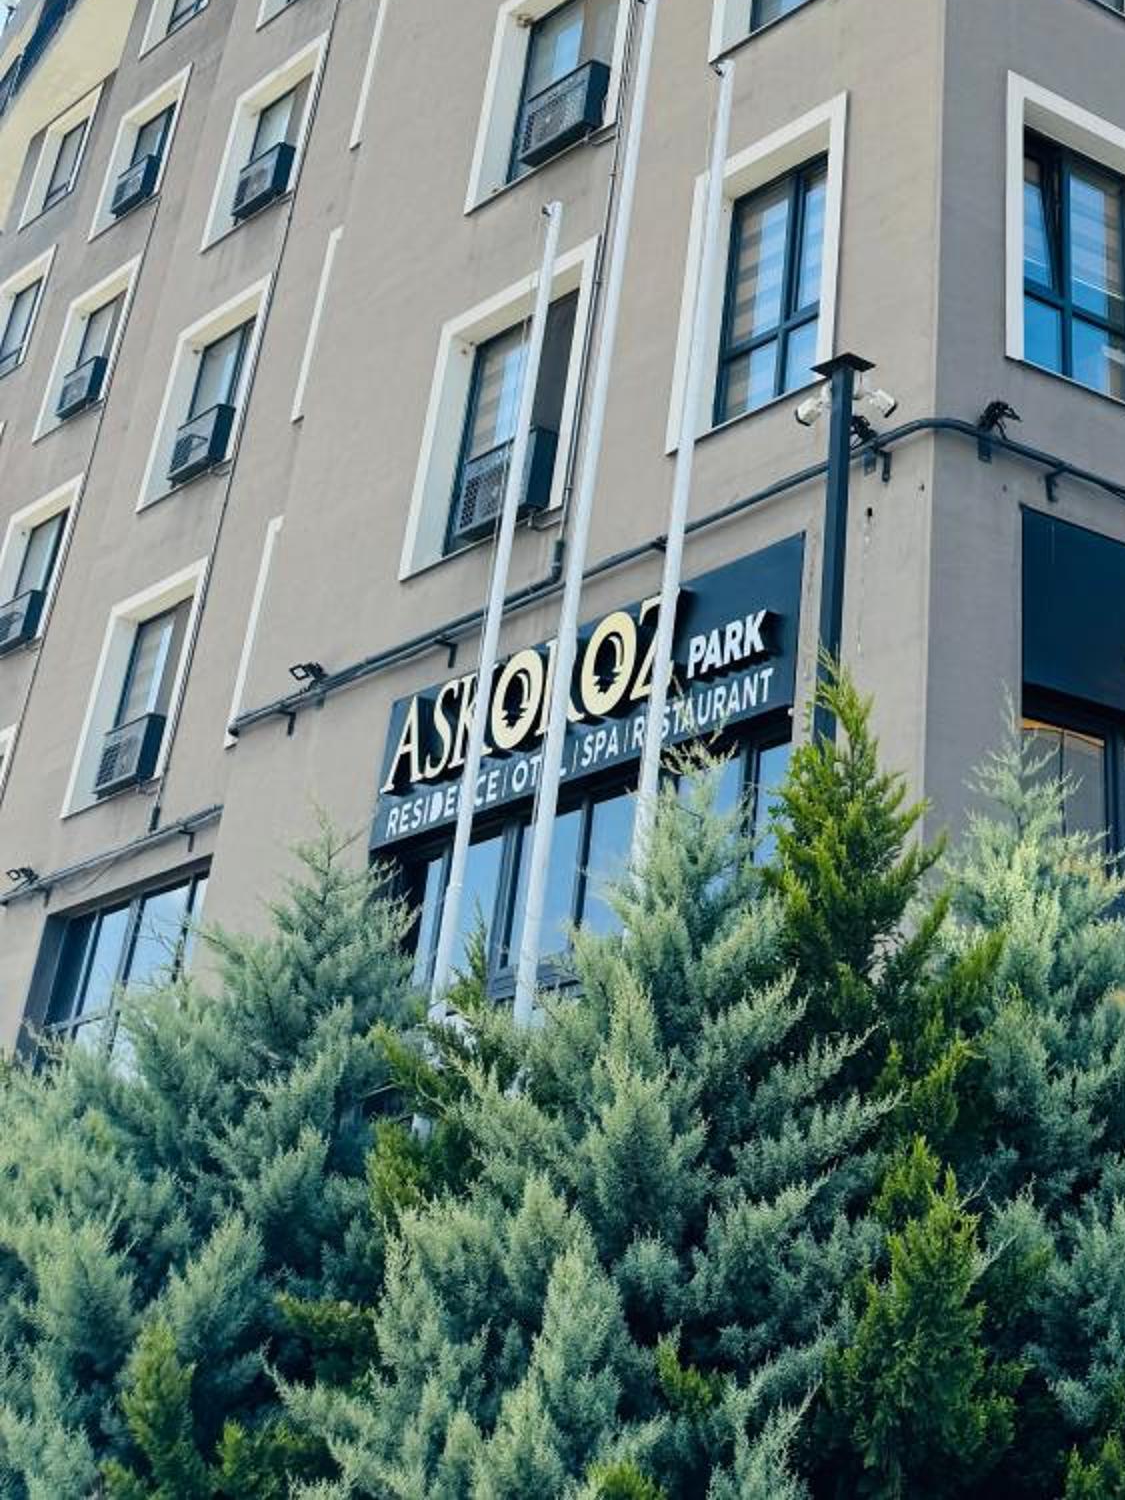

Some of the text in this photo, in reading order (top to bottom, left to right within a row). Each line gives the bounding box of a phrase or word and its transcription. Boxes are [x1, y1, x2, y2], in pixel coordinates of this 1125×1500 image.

[687, 609, 767, 679] PARK
[386, 769, 500, 838] RESIDECE
[581, 726, 619, 768] SPA
[632, 668, 774, 750] RSTAURANT
